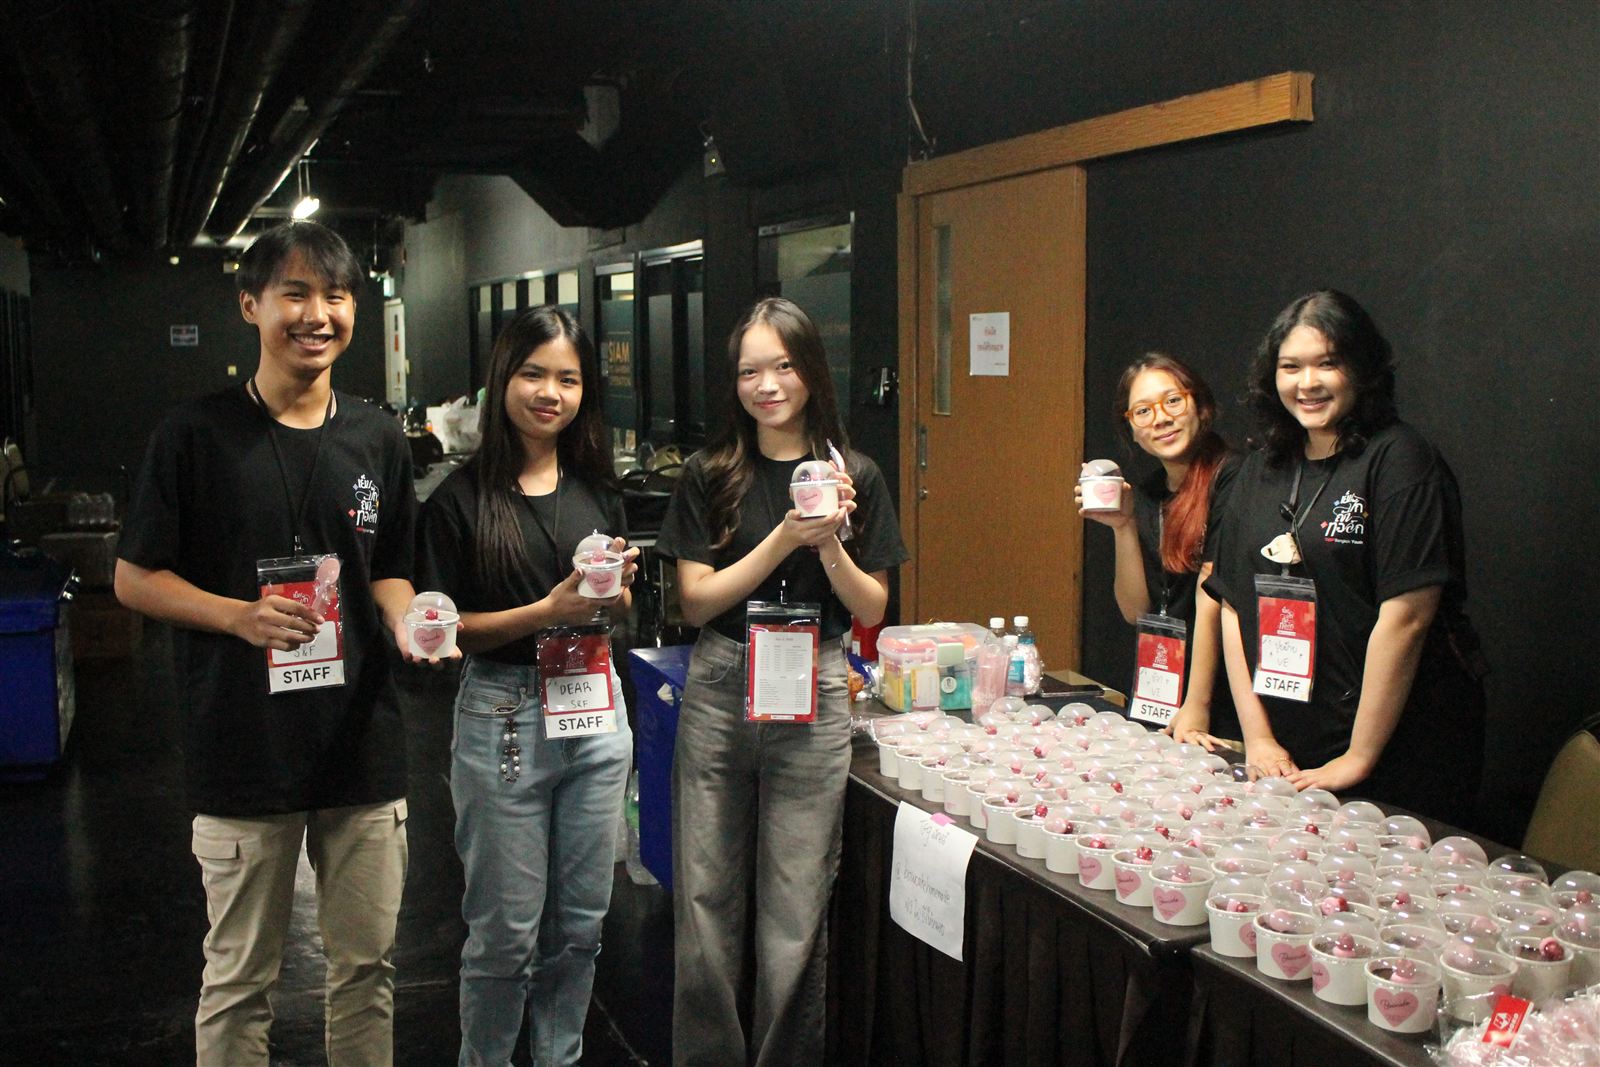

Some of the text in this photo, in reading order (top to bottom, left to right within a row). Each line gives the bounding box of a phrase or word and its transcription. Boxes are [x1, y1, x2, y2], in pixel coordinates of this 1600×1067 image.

[282, 666, 331, 685] STAFF
[559, 681, 592, 696] DEAR
[1264, 676, 1301, 693] STAFF
[1140, 703, 1172, 720] STAFF
[558, 715, 604, 731] STAFF
